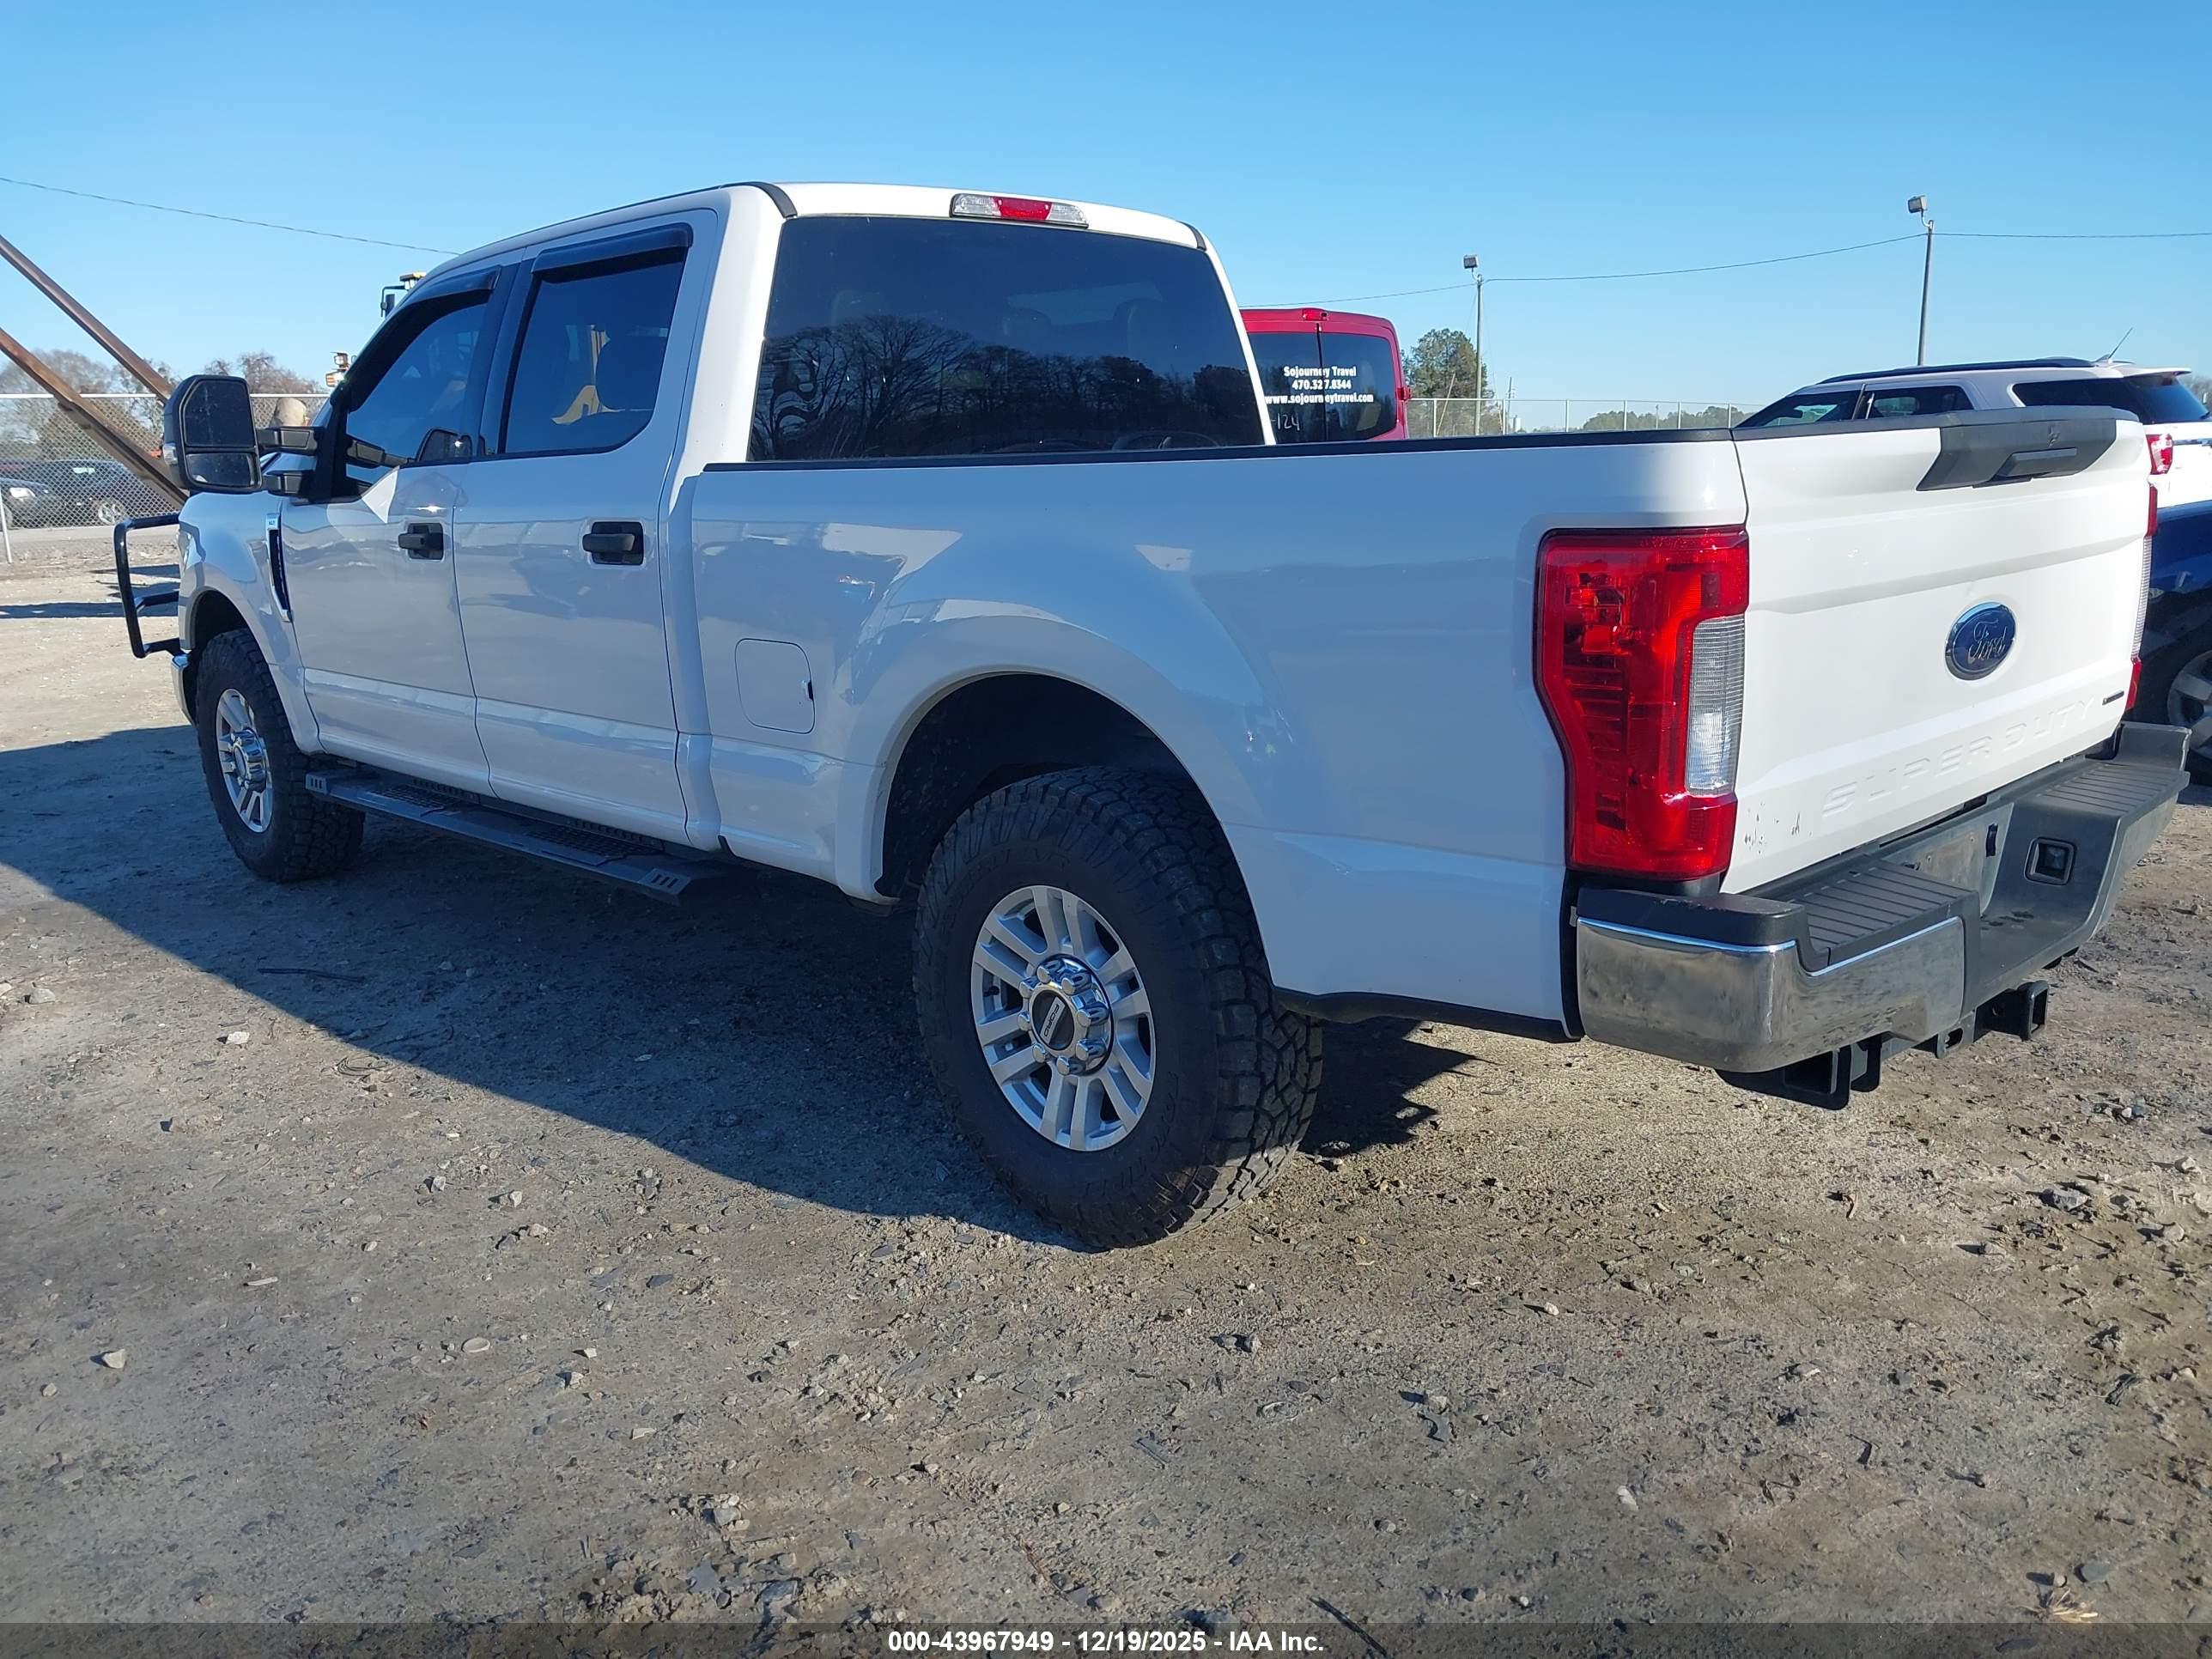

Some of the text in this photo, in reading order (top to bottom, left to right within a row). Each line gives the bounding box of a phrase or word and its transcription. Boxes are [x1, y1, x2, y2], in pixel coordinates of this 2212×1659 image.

[1283, 366, 1357, 379] Sojourney Travel
[1264, 392, 1374, 405] www.sojourneytravel.com
[1967, 618, 2008, 665] Ford
[1043, 1004, 1060, 1037] FORD
